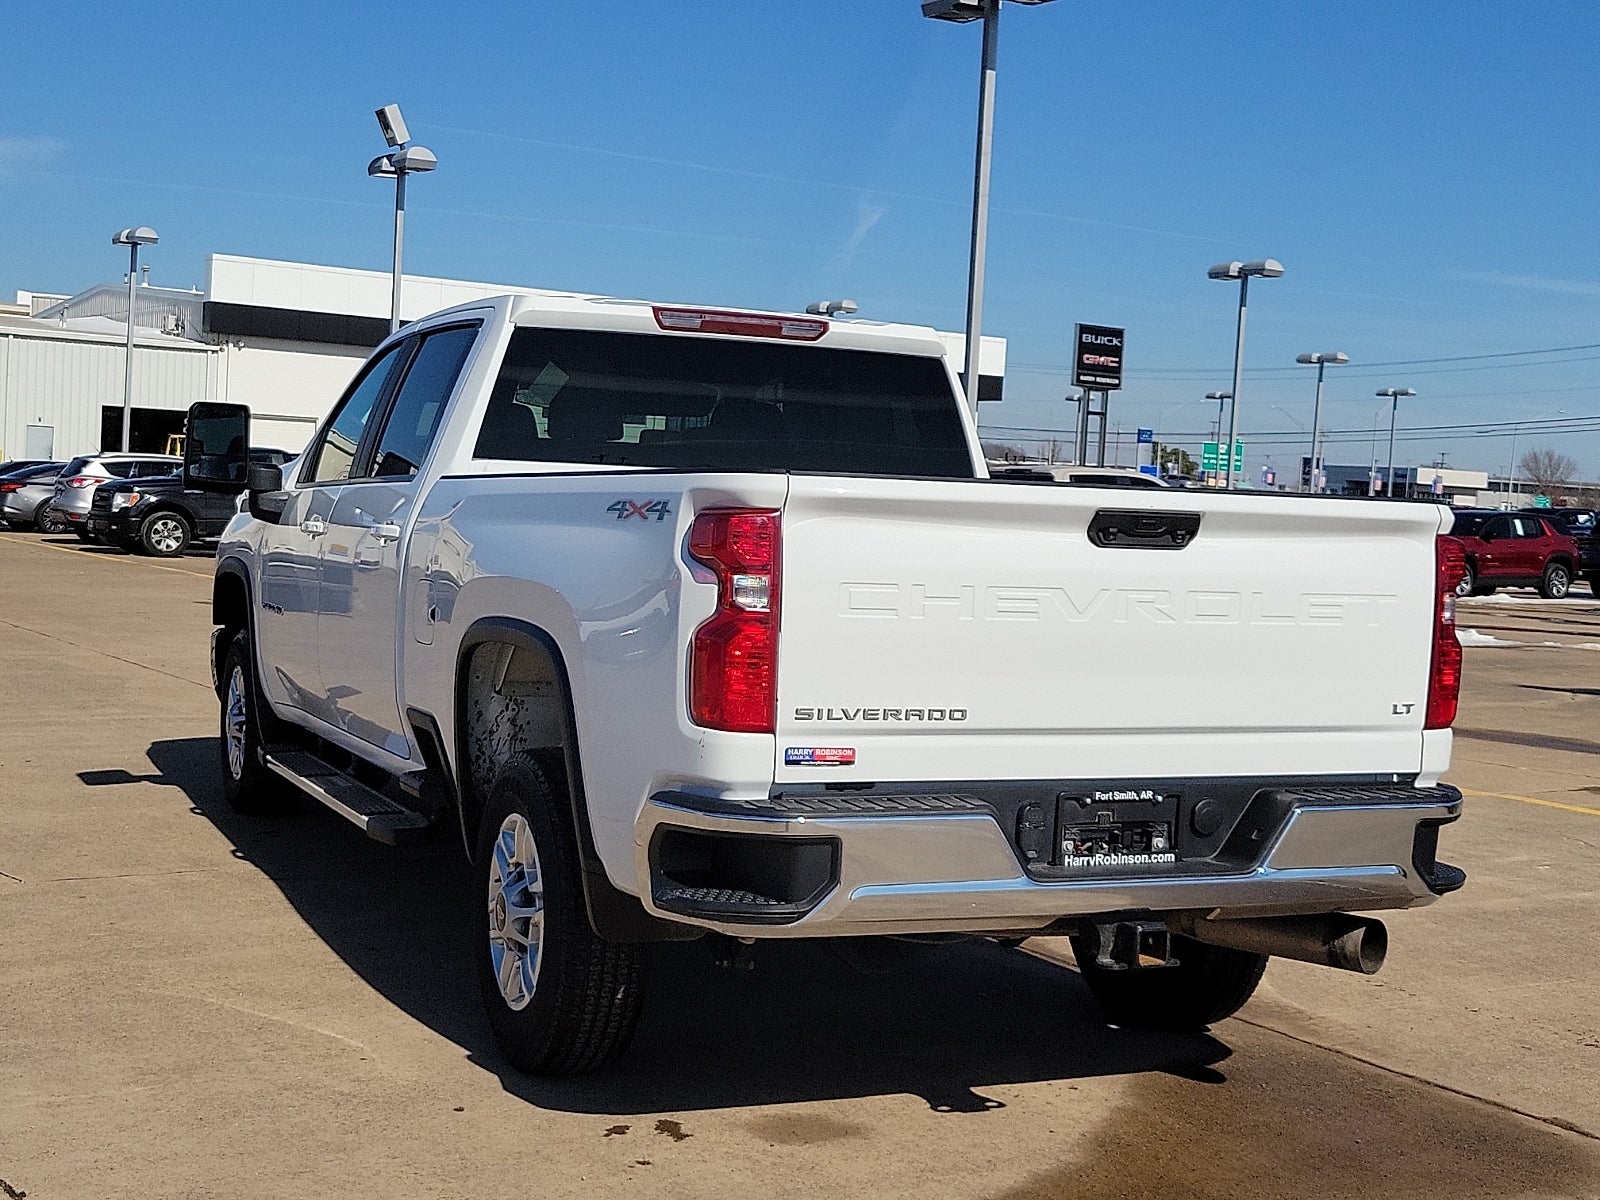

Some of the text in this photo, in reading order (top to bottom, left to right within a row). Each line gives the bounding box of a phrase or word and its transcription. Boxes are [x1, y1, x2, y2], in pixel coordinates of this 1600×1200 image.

[1082, 333, 1122, 346] BUICK
[1082, 353, 1120, 367] GMC
[837, 581, 1398, 626] CHEVROLET
[794, 707, 968, 721] SILVERADO
[1391, 703, 1416, 715] LT
[815, 748, 853, 756] ROBINSON
[1095, 790, 1154, 801] Fort Smith, AR
[1064, 852, 1176, 867] HarryRobinson.com
